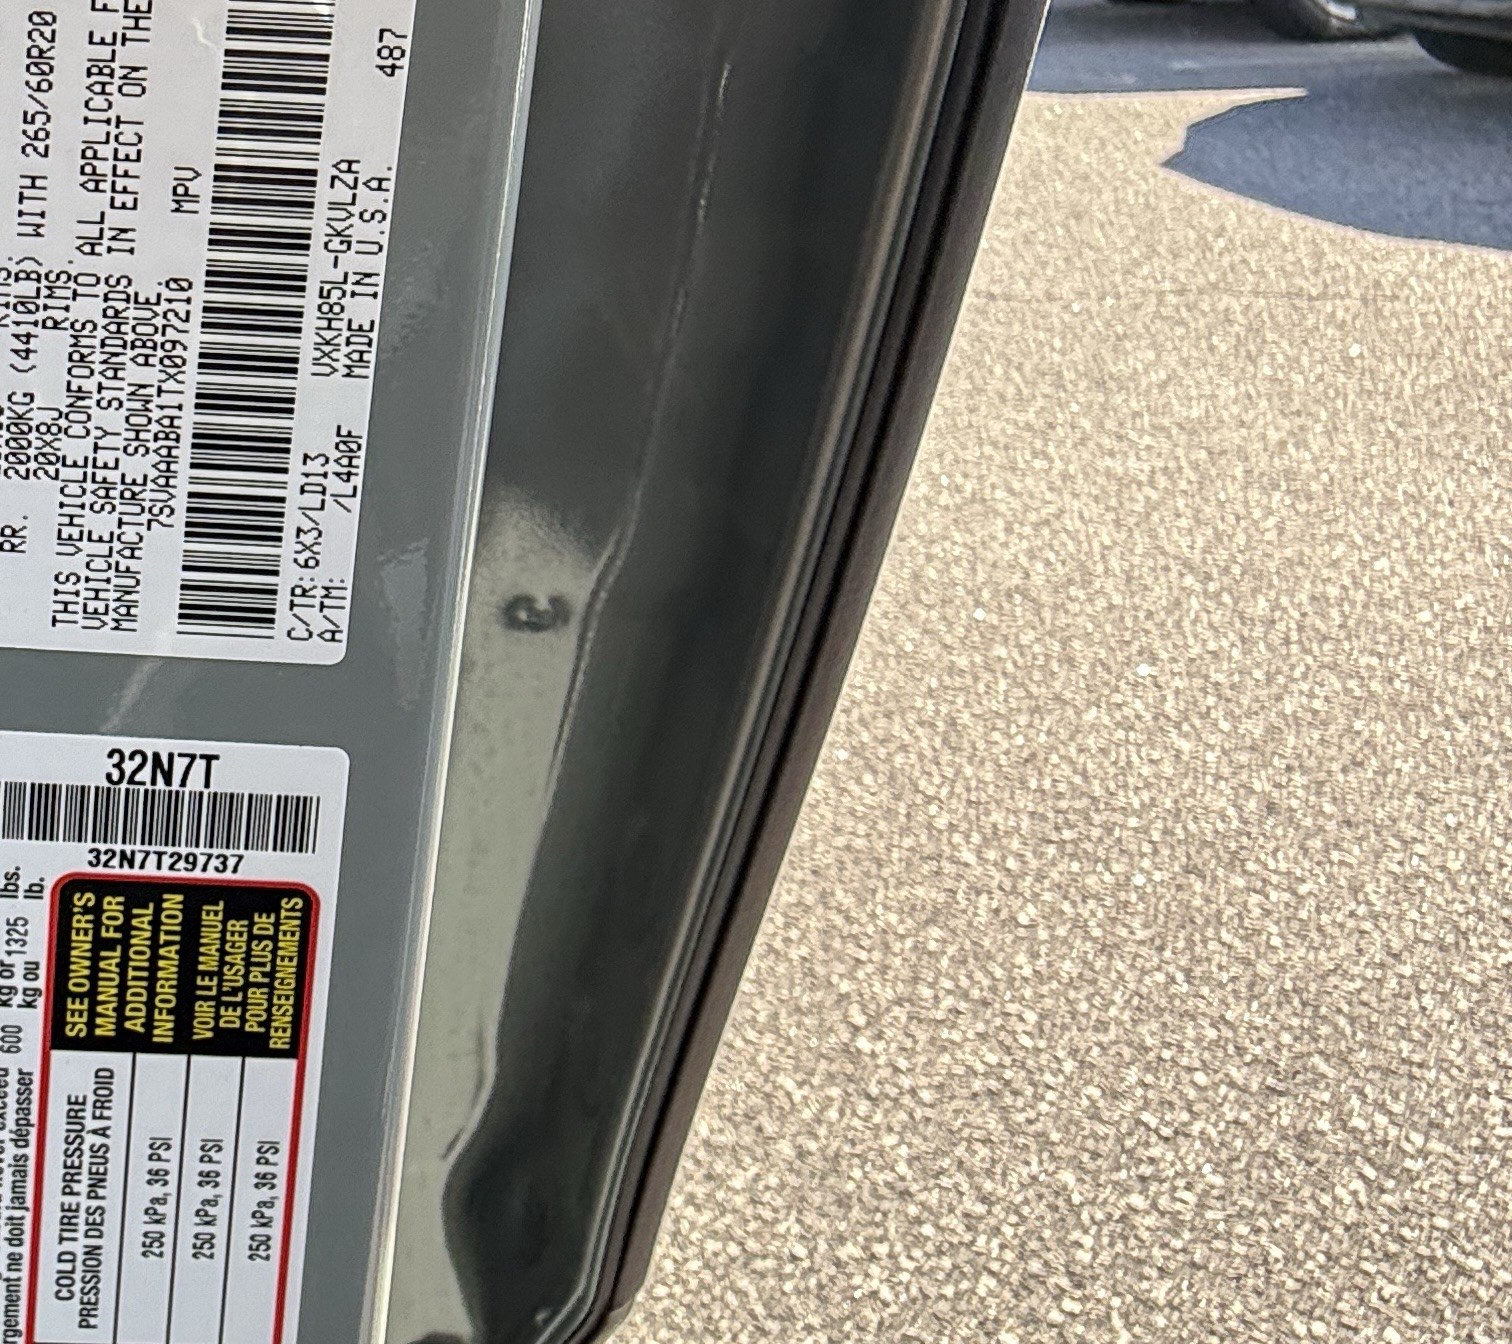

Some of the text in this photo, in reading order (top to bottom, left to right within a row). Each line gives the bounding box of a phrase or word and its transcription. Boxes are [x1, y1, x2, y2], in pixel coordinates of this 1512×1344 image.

[20, 10, 57, 159] 265/60R20
[79, 30, 118, 194] APPLICABLE
[117, 65, 149, 98] ON
[16, 174, 48, 238] WITH
[109, 114, 144, 211] EFFECT
[341, 28, 408, 380] MADE IN U.S.A. 487
[71, 272, 101, 302] TO
[74, 210, 106, 257] ALL
[106, 226, 137, 256] IN
[310, 158, 361, 377] VXKH85L-GKVLZA
[9, 256, 43, 374] (4410LB)
[95, 274, 133, 411] STANDARDS
[146, 166, 202, 532] 7SVAAABA1TX097210 MPV
[2, 391, 35, 481] 2000KG
[63, 318, 98, 440] CONFORMS
[55, 454, 89, 557] VEHICLE
[89, 426, 122, 515] SAFETY
[110, 281, 163, 633] MANUFACTURE SHOWN ABOVE.
[51, 571, 82, 628] THIS
[81, 529, 115, 631] VEHICLE
[105, 747, 221, 790] 32N7T
[87, 847, 245, 875] 32N7T29737
[4, 916, 29, 957] 1325
[94, 895, 125, 1037] MANUAL FOR
[123, 902, 154, 1033] ADDITIONAL
[152, 893, 184, 1043] INFORMATION
[192, 900, 225, 1040] VOIR LE MANUEL
[244, 912, 276, 1033] POUR PLUS DE
[269, 897, 304, 1049] RENSEIGNEMENTS
[64, 997, 89, 1038] SEE
[218, 1006, 242, 1029] DE
[54, 1094, 87, 1302] COLD TIRE PRESSURE
[77, 1067, 115, 1330] PRESSION DES PNEUS FROID
[140, 1136, 173, 1259] 250 kPa, 36 PSI
